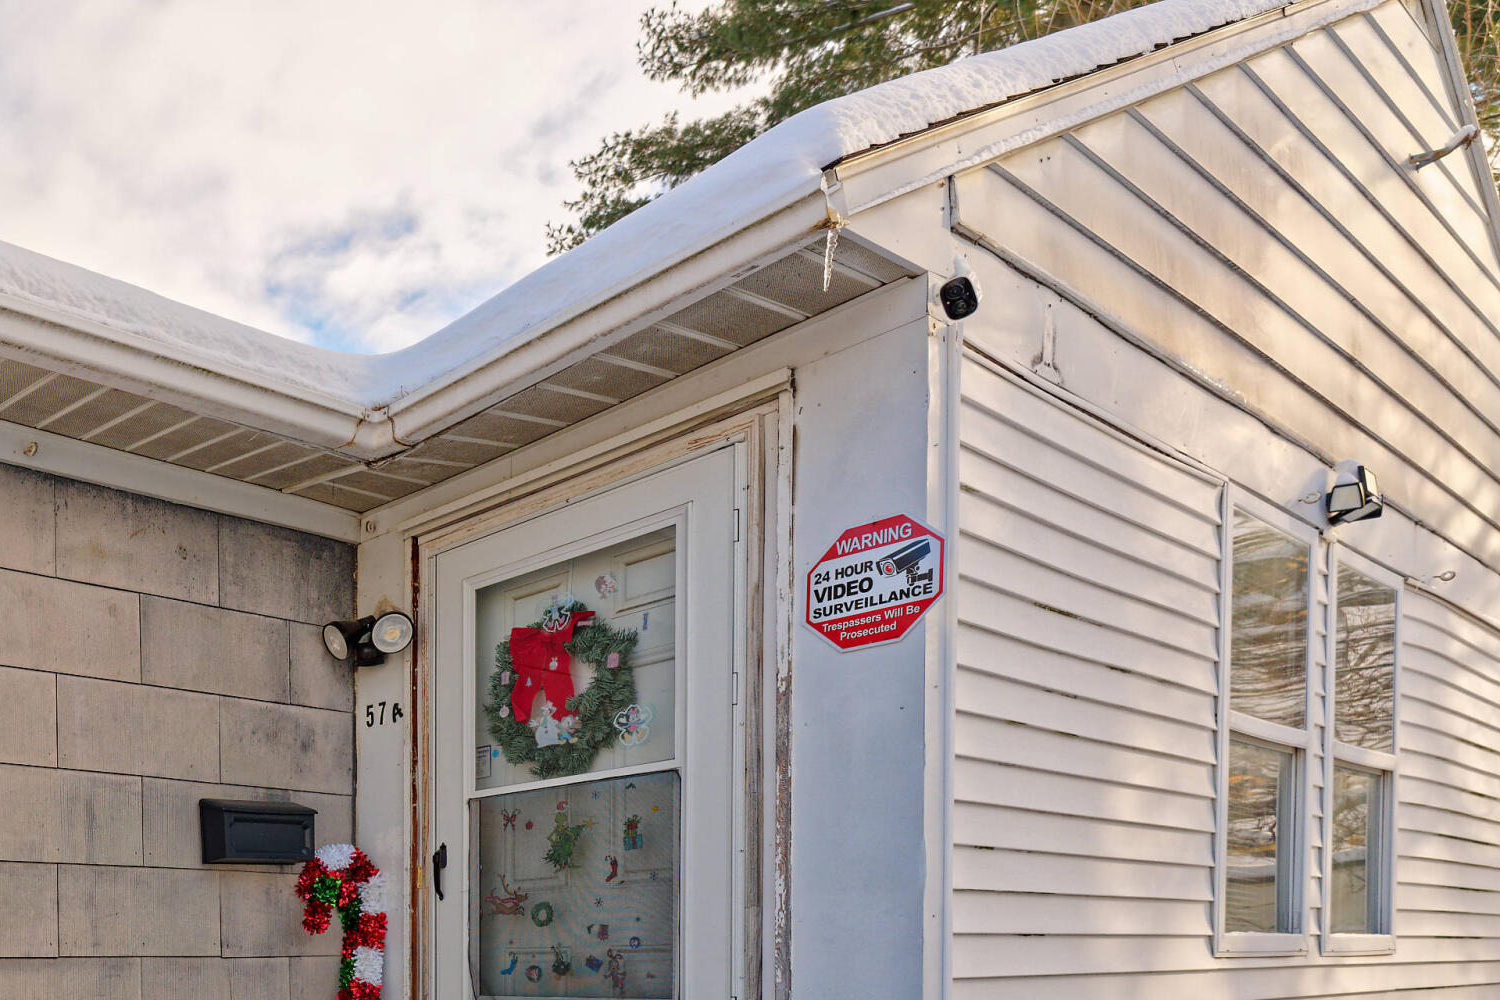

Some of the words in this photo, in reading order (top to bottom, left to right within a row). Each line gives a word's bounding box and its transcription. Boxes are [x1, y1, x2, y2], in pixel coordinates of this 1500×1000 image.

[835, 522, 912, 555] WARNING
[814, 570, 830, 585] 24
[834, 560, 874, 580] HOUR
[812, 582, 933, 619] SURVEILLANCE
[813, 577, 873, 603] VIDEO
[822, 613, 882, 633] Trespassers
[883, 607, 904, 619] Will
[906, 604, 921, 615] Be
[840, 620, 897, 641] Prosecuted
